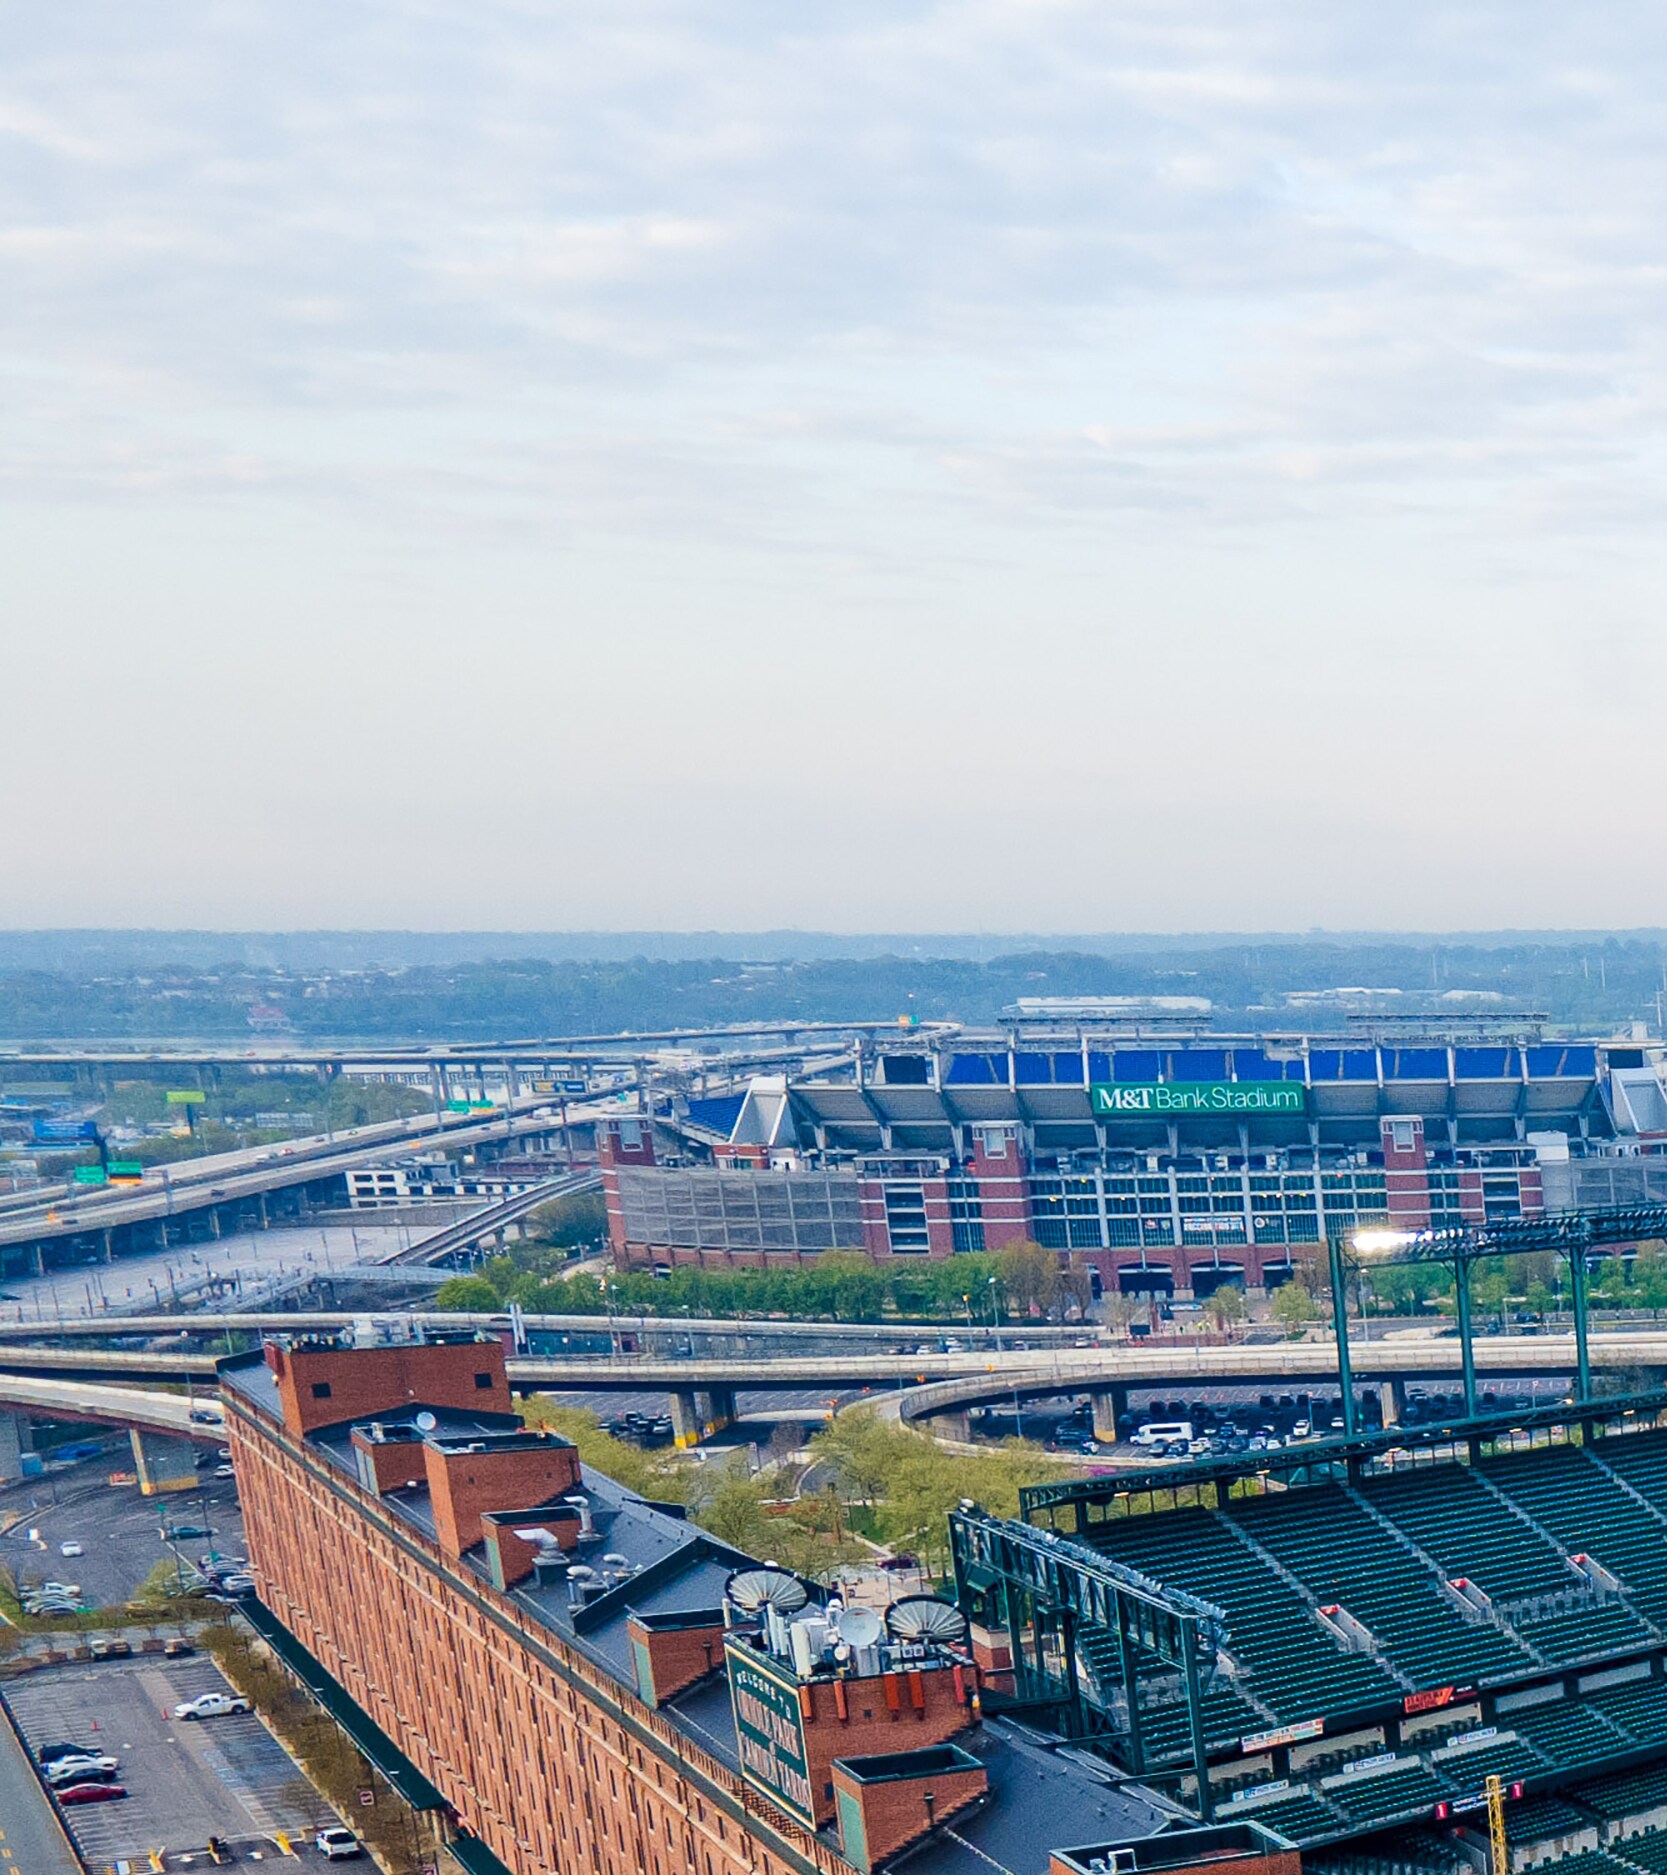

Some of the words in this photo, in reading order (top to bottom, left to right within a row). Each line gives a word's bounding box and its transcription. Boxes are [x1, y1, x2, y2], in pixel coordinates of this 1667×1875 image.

[1098, 1088, 1153, 1110] M&T
[1155, 1087, 1210, 1109] Bank
[1212, 1086, 1299, 1109] Stadium
[736, 1670, 777, 1701] WELCOME
